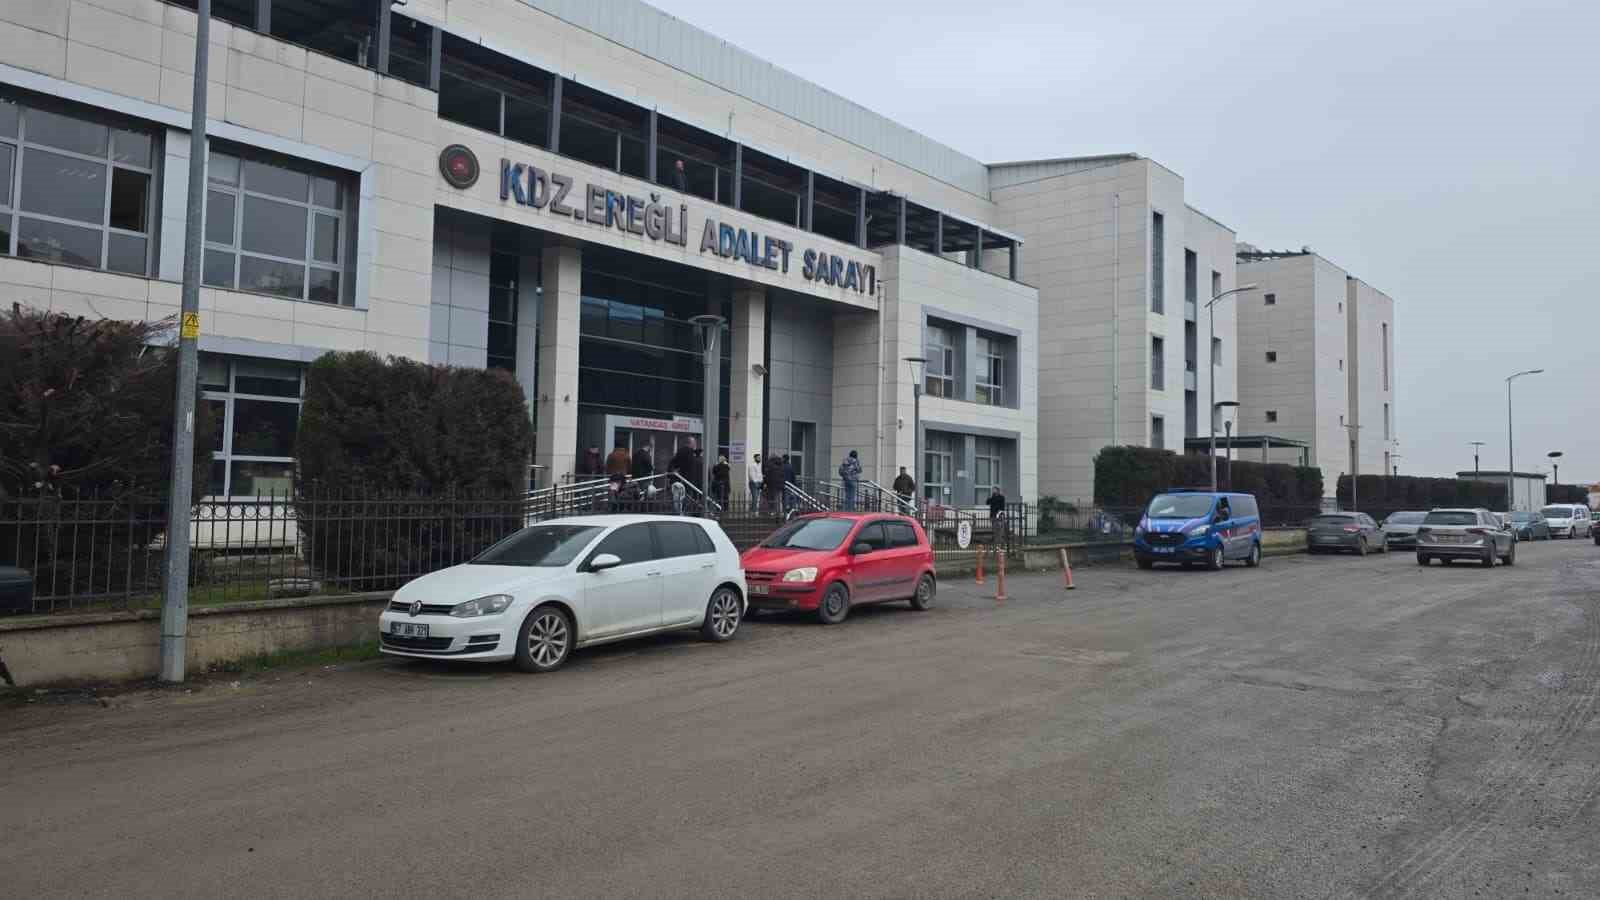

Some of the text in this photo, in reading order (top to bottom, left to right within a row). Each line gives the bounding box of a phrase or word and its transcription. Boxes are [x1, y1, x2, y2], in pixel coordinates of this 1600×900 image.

[499, 157, 876, 296] KDZ.EREĞLİ ADALET SARAYI
